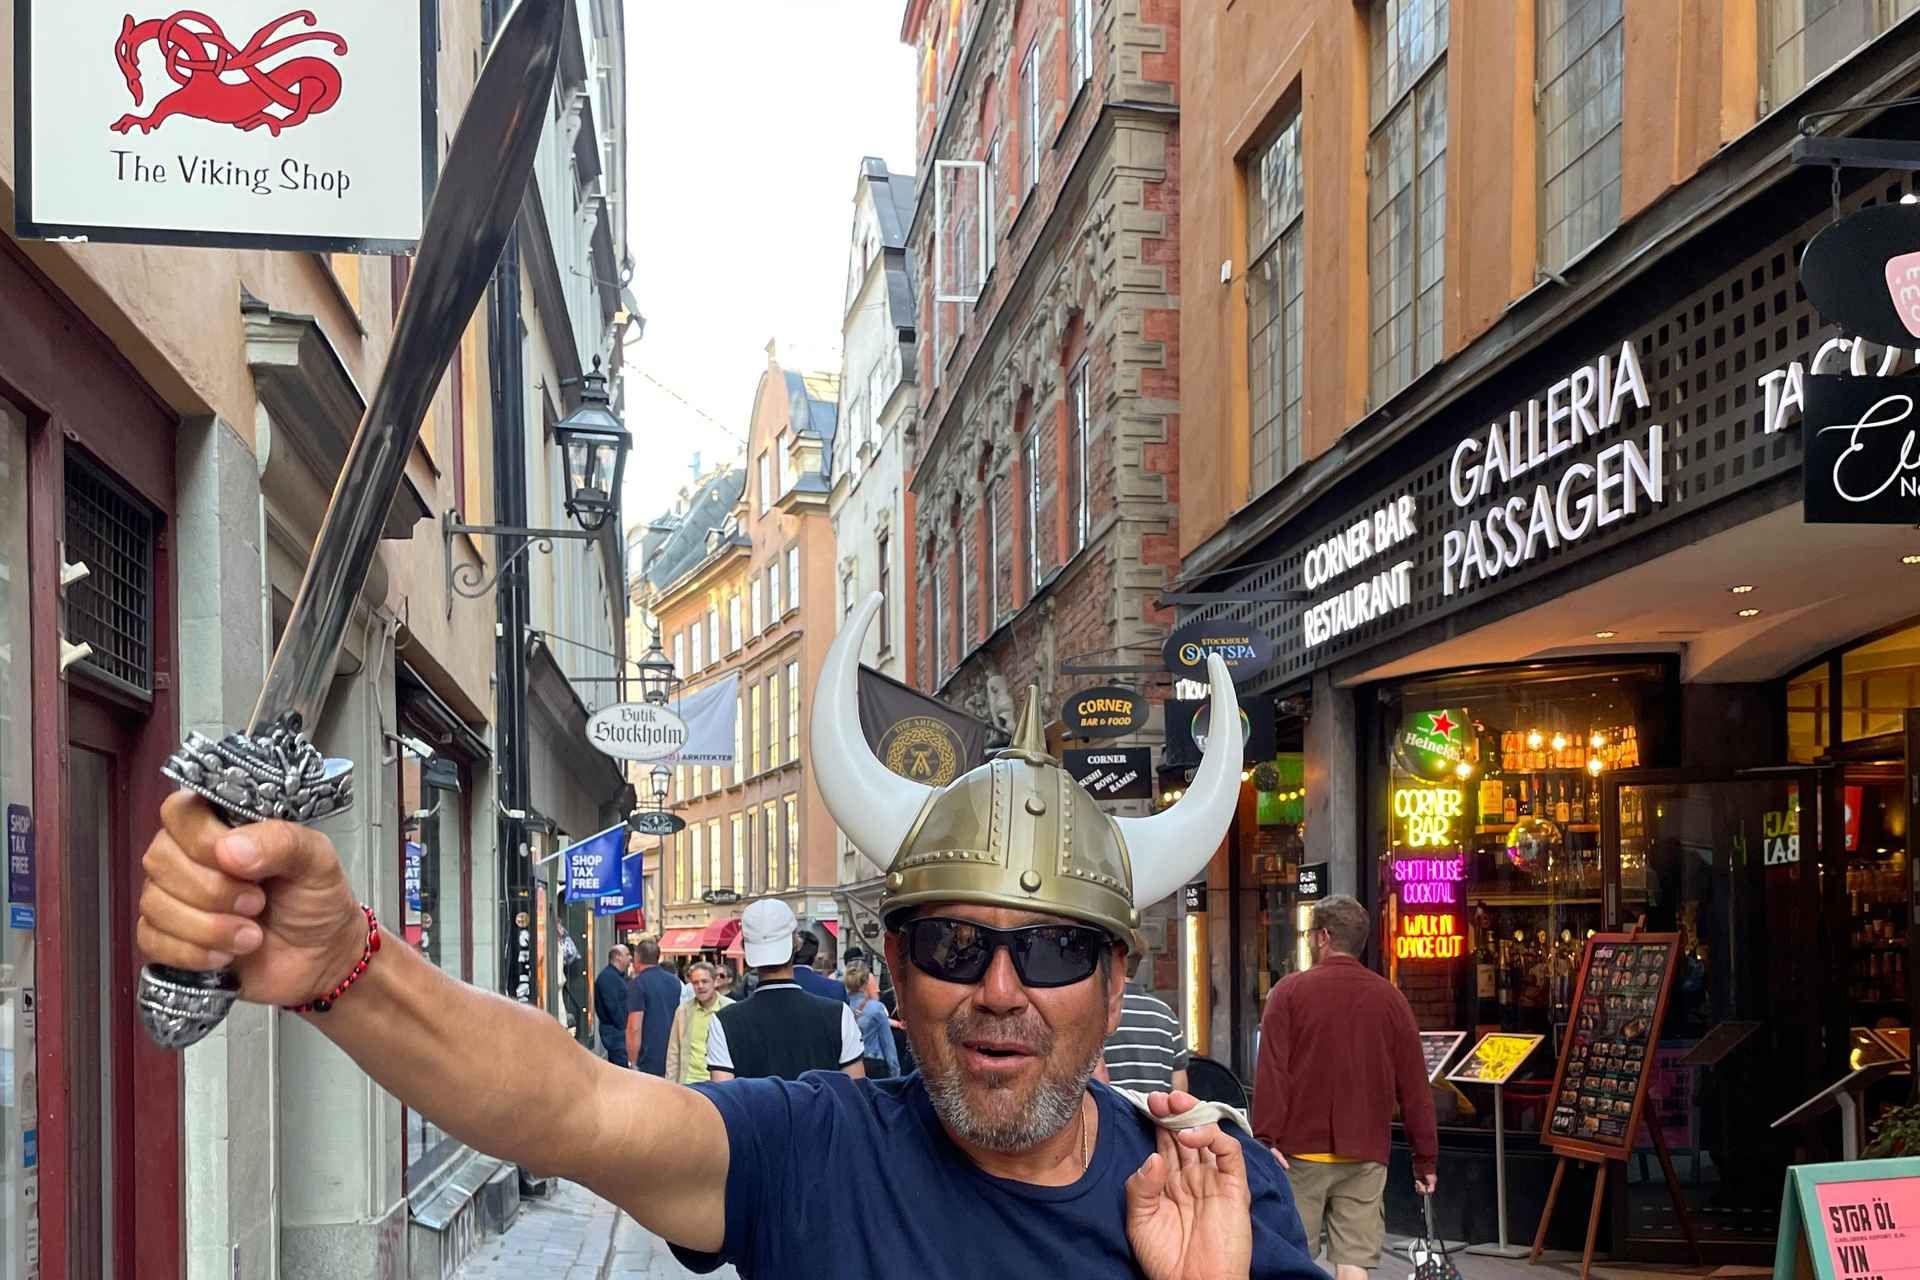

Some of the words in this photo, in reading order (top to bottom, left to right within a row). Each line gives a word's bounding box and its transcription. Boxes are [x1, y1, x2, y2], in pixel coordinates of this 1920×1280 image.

[110, 150, 167, 183] The
[178, 155, 272, 195] Viking
[279, 158, 351, 199] Shop
[1449, 340, 1651, 507] GALLERIA
[1443, 424, 1663, 596] PASSAGEN
[1304, 519, 1374, 591] CORNER
[1374, 495, 1417, 553] BAR
[1304, 560, 1415, 648] RESTAURANT
[1201, 636, 1249, 645] STOCKHOLM
[621, 708, 657, 723] Butik
[1078, 699, 1132, 715] CORNER
[1081, 718, 1099, 727] BAR
[1108, 716, 1132, 726] FOOD
[594, 721, 682, 746] Stockholm
[1087, 754, 1127, 765] CORNER
[1078, 768, 1104, 788] SUSHI
[1094, 772, 1119, 791] BOWL
[1395, 788, 1463, 817] CORNER
[11, 814, 31, 834] SHOP
[1408, 815, 1451, 847] BAR
[11, 835, 27, 854] TAX
[11, 856, 29, 874] FREE
[572, 855, 603, 866] SHOP
[1395, 860, 1425, 881] SHOT
[1427, 860, 1464, 881] HOUSE
[572, 867, 594, 877] TAX
[572, 878, 600, 889] FREE
[1403, 882, 1456, 903] COCKTAIL
[600, 896, 624, 906] FREE
[1404, 914, 1438, 935] WALK
[1439, 914, 1453, 935] IN
[1397, 936, 1435, 958] DANCE
[1436, 935, 1464, 958] OUT
[1828, 1204, 1872, 1233] STOR
[1872, 1197, 1896, 1230] ÖL
[1837, 1245, 1870, 1274] VIN
